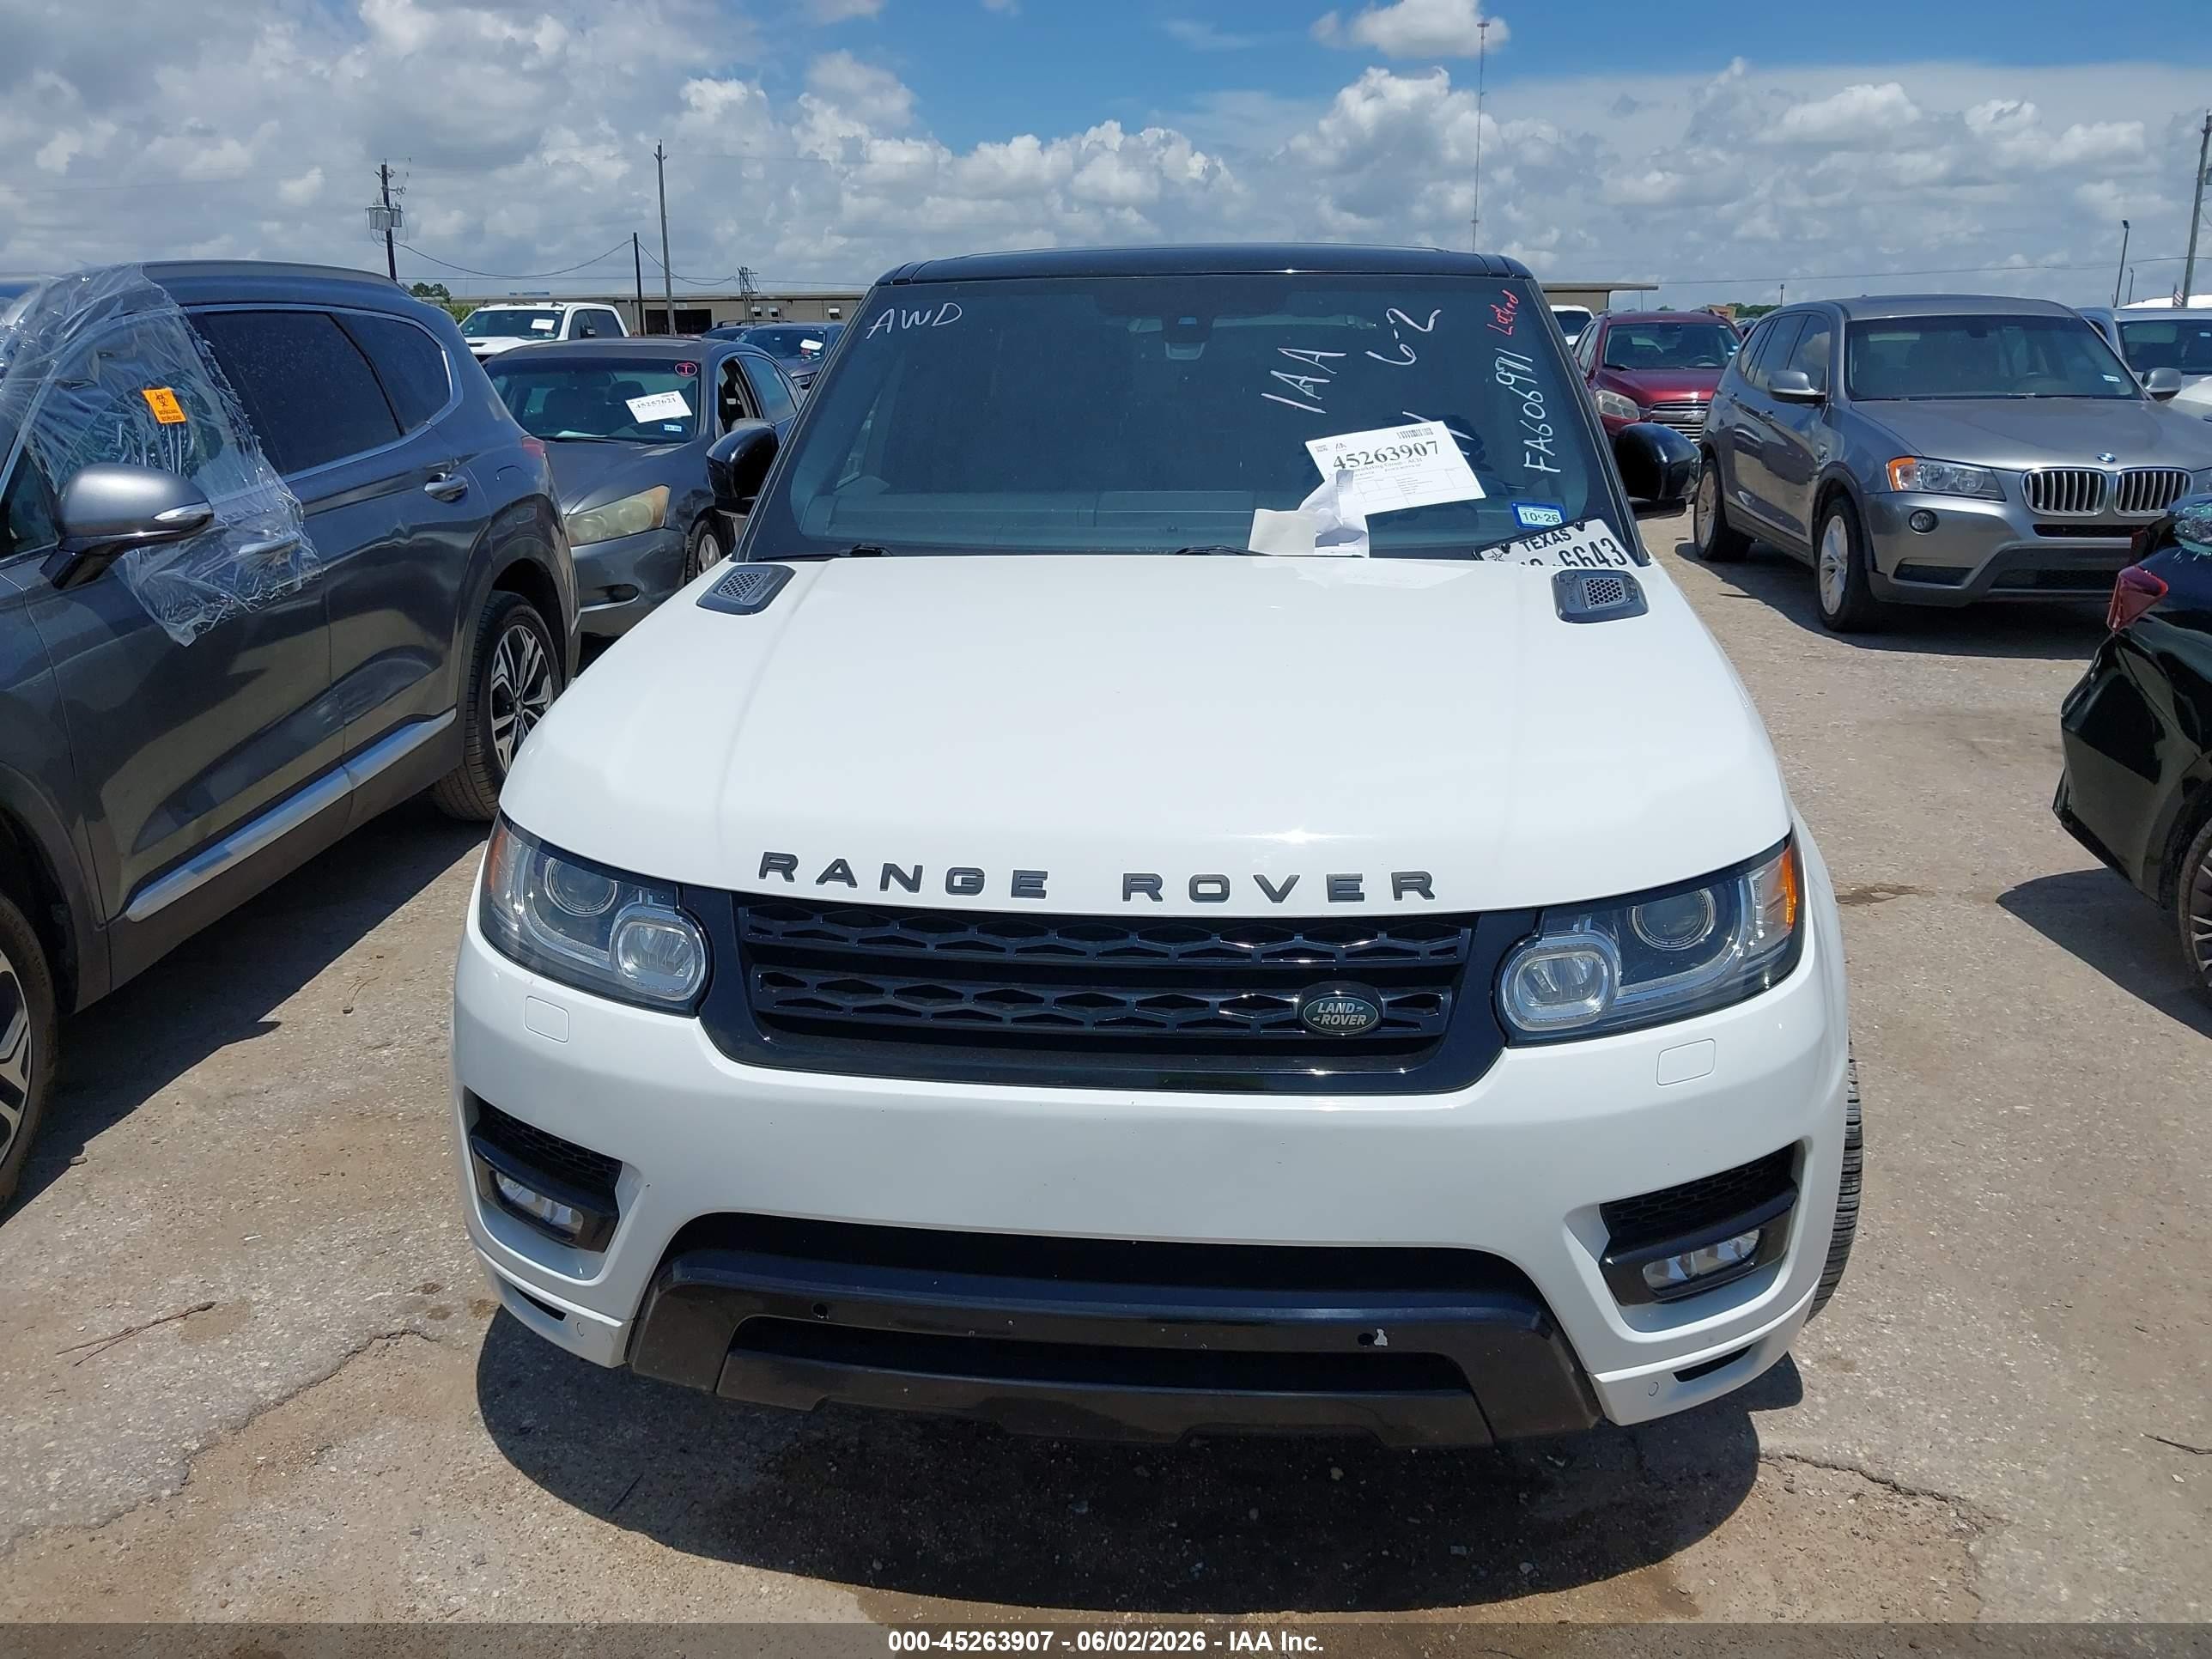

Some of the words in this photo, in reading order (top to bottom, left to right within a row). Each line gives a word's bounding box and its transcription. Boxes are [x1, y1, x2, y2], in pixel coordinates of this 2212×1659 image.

[866, 302, 963, 340] AWD
[1364, 307, 1442, 366] 6-2
[1333, 441, 1438, 470] 45263907
[1519, 529, 1572, 552] TEXAS
[758, 851, 1048, 899] RANGE
[1122, 871, 1436, 903] ROVER
[1317, 1002, 1356, 1013] LAND
[1321, 1014, 1367, 1025] ROVER
